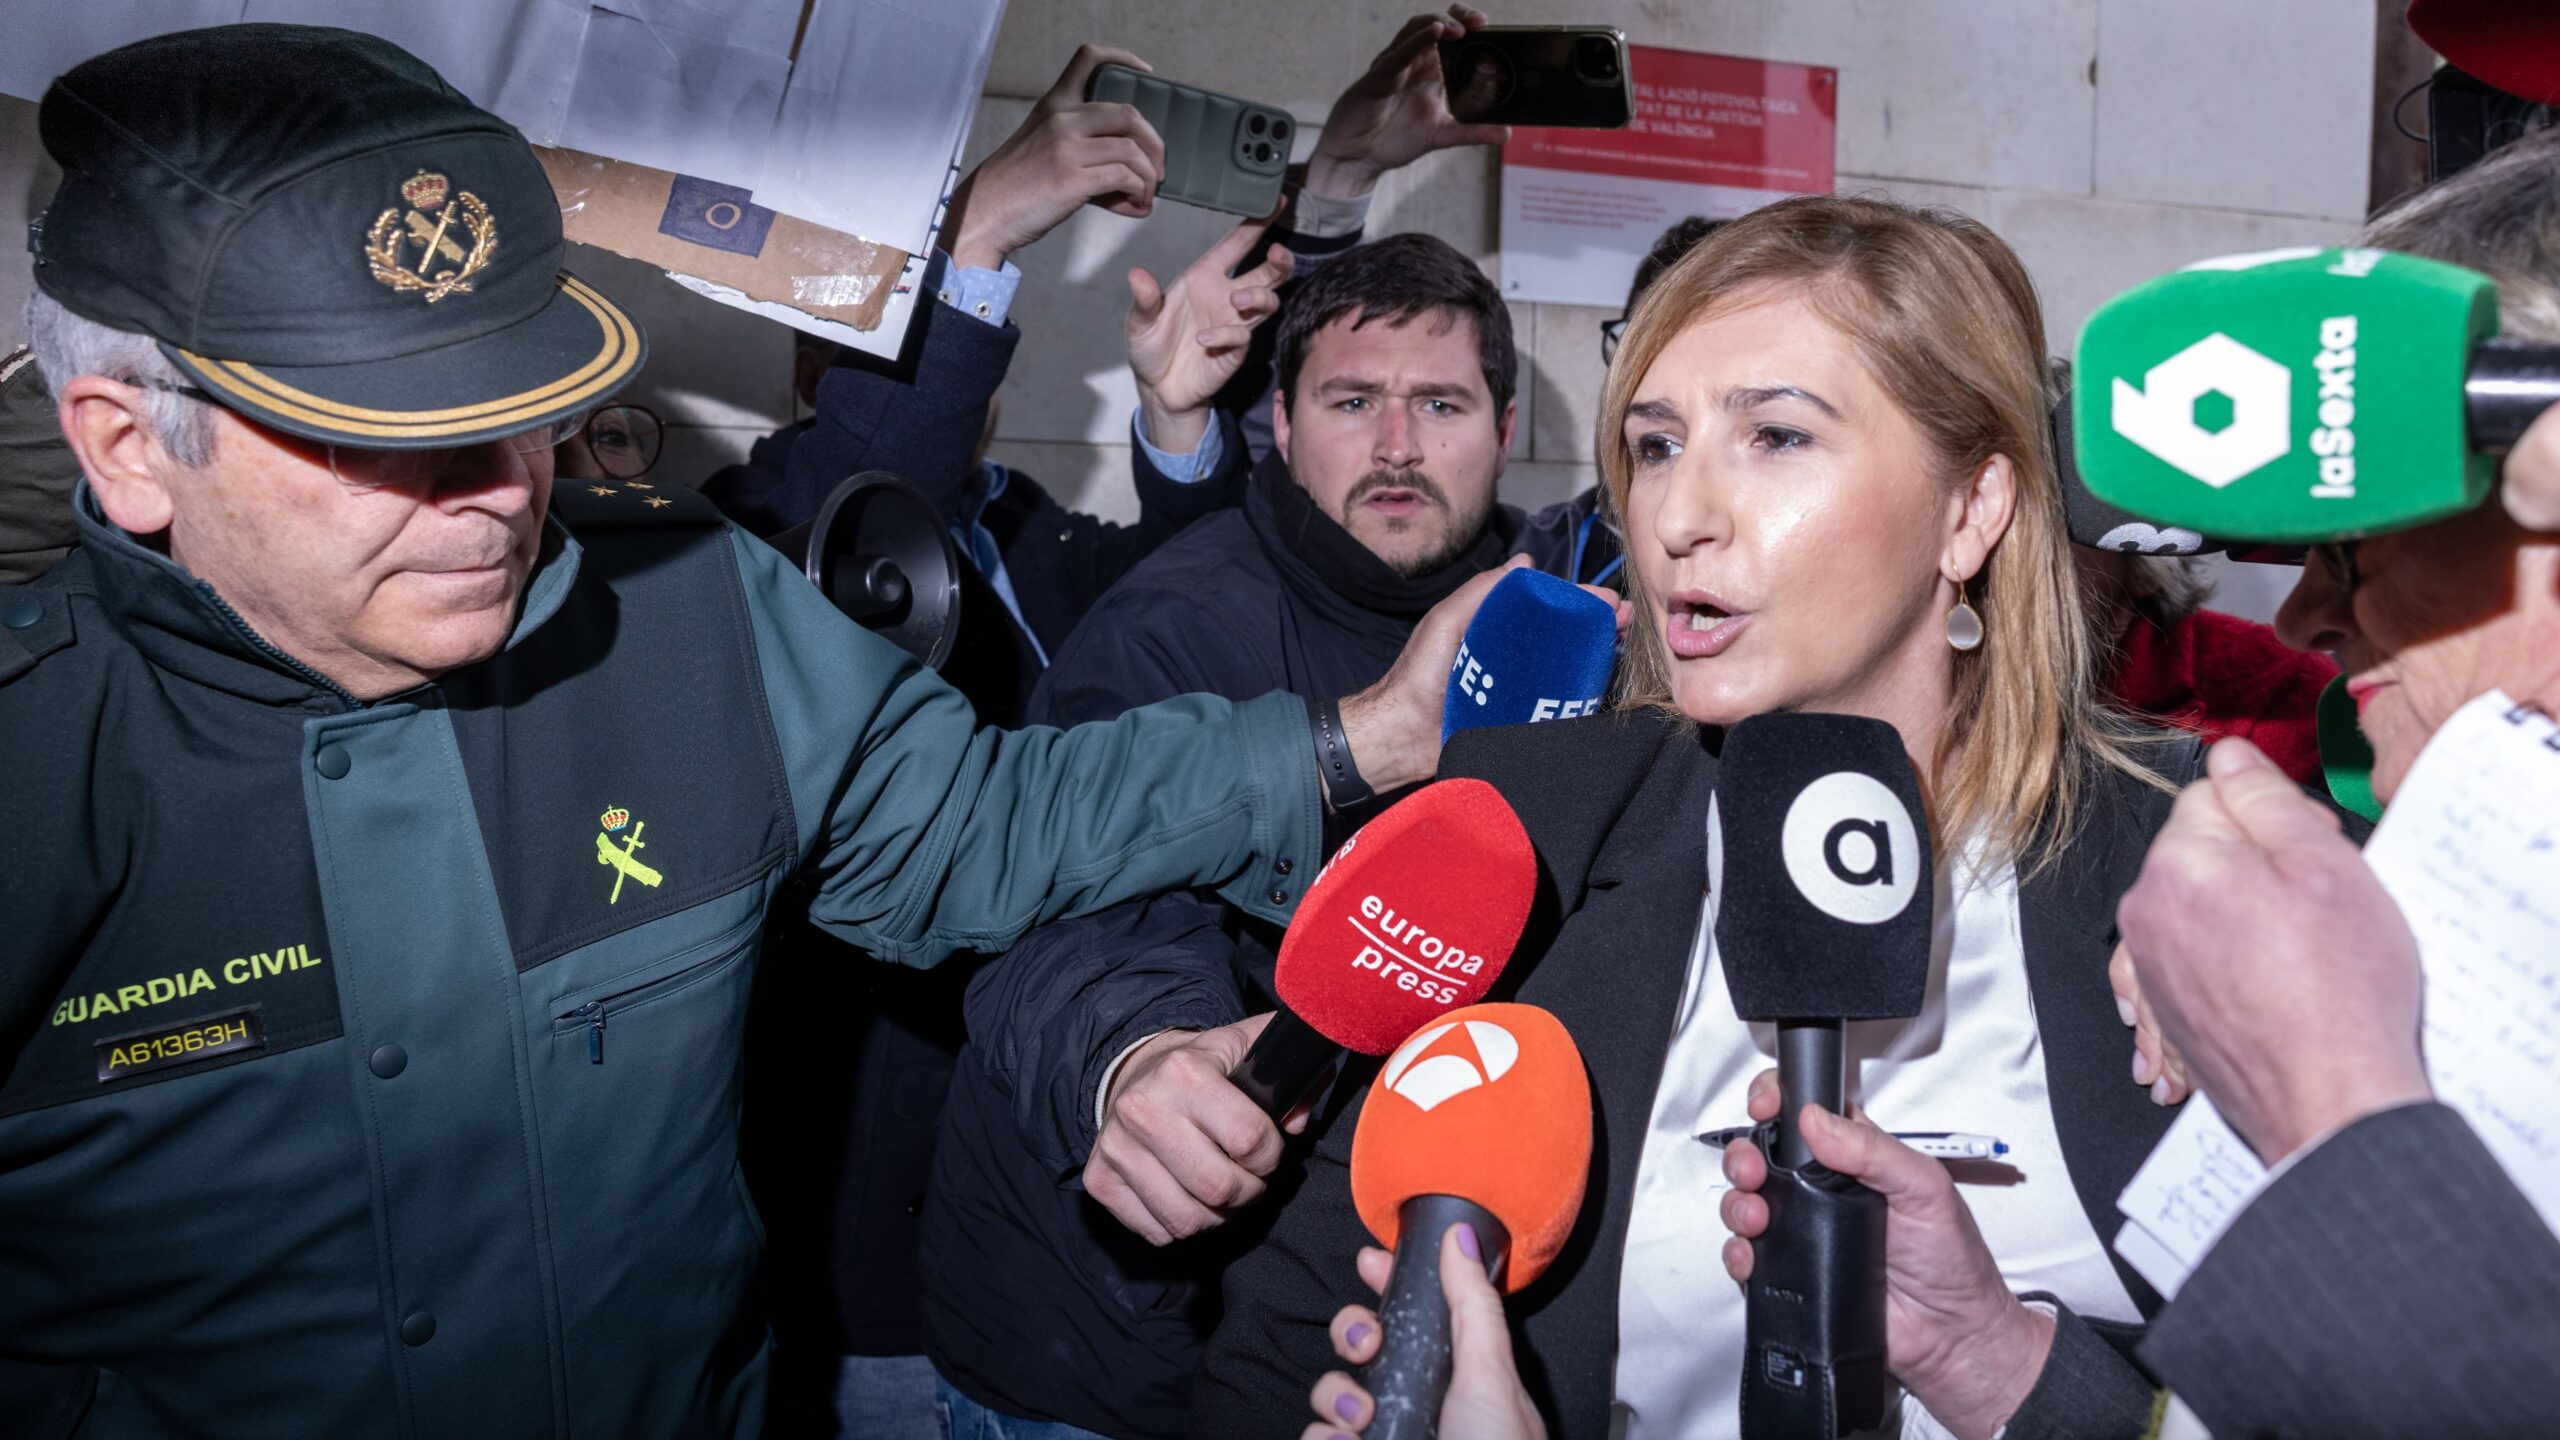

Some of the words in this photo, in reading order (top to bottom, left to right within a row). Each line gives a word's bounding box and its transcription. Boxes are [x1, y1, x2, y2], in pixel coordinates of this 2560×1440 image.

[2310, 315, 2358, 498] laSexta
[1823, 817, 1894, 886] a
[1360, 895, 1484, 975] europa
[51, 967, 217, 1027] GUARDIA
[223, 944, 322, 985] CIVIL
[1351, 945, 1460, 1004] press
[108, 1019, 248, 1070] A61363H
